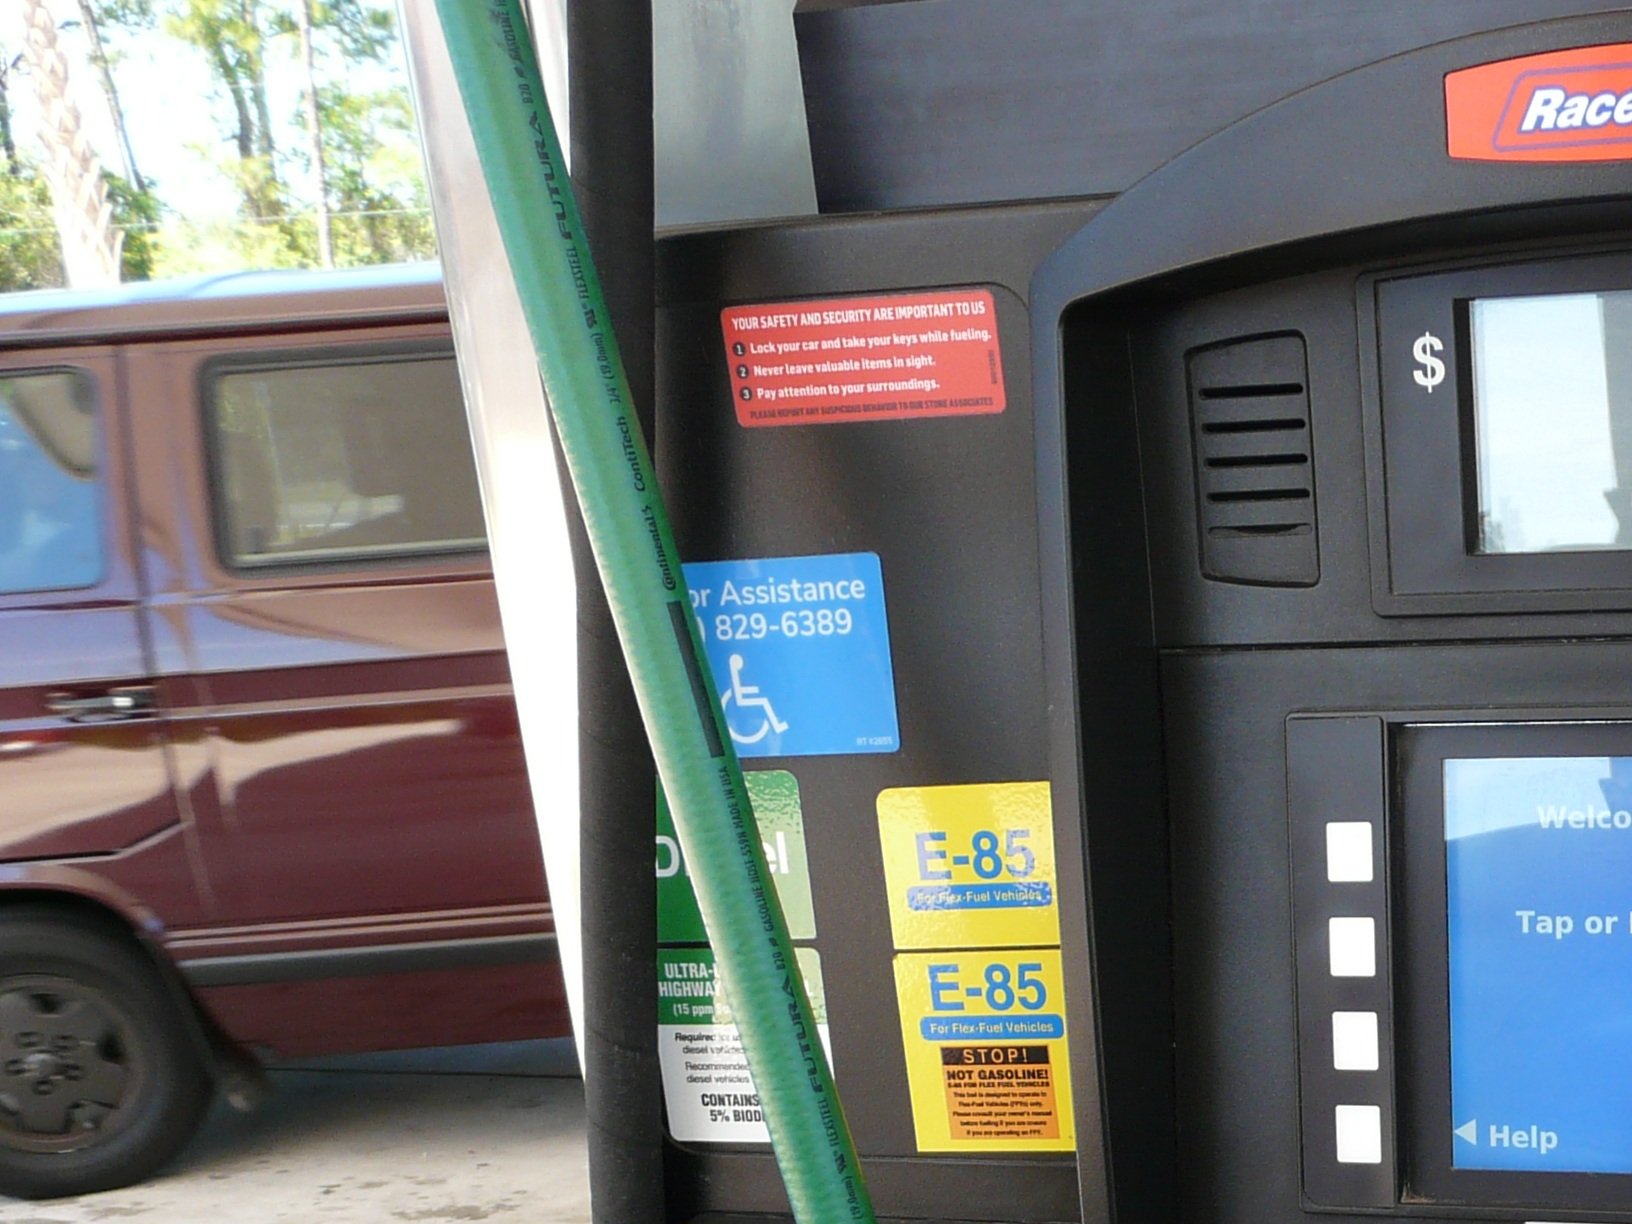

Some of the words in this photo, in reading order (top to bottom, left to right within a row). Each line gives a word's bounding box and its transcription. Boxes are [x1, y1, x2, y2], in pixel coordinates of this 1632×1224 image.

[732, 317, 760, 331] YOUR
[761, 314, 799, 328] SAFETY
[800, 312, 822, 326] AND
[823, 310, 872, 325] SECURITY
[873, 308, 894, 321] ARE
[896, 303, 954, 319] IMPORTANT
[955, 302, 970, 315] TO
[971, 301, 985, 314] US
[1413, 332, 1445, 393] $
[757, 388, 777, 401] Pay
[778, 383, 826, 399] attention
[827, 382, 839, 394] to
[841, 381, 865, 395] your
[867, 378, 940, 392] surroundings.
[720, 578, 865, 606] Assistance
[715, 608, 853, 641] 829-6389
[915, 829, 1035, 881] E-85
[1516, 911, 1575, 939] Tap
[1584, 914, 1618, 935] or
[927, 963, 1047, 1011] E-85
[930, 1023, 948, 1034] For
[1006, 1022, 1053, 1032] Vehicles
[963, 1048, 1027, 1063] STOP!
[947, 1070, 973, 1081] NOT
[978, 1069, 1049, 1080] GASOLINE!
[701, 1094, 759, 1106] CONTAINS
[1489, 1125, 1559, 1154] Help
